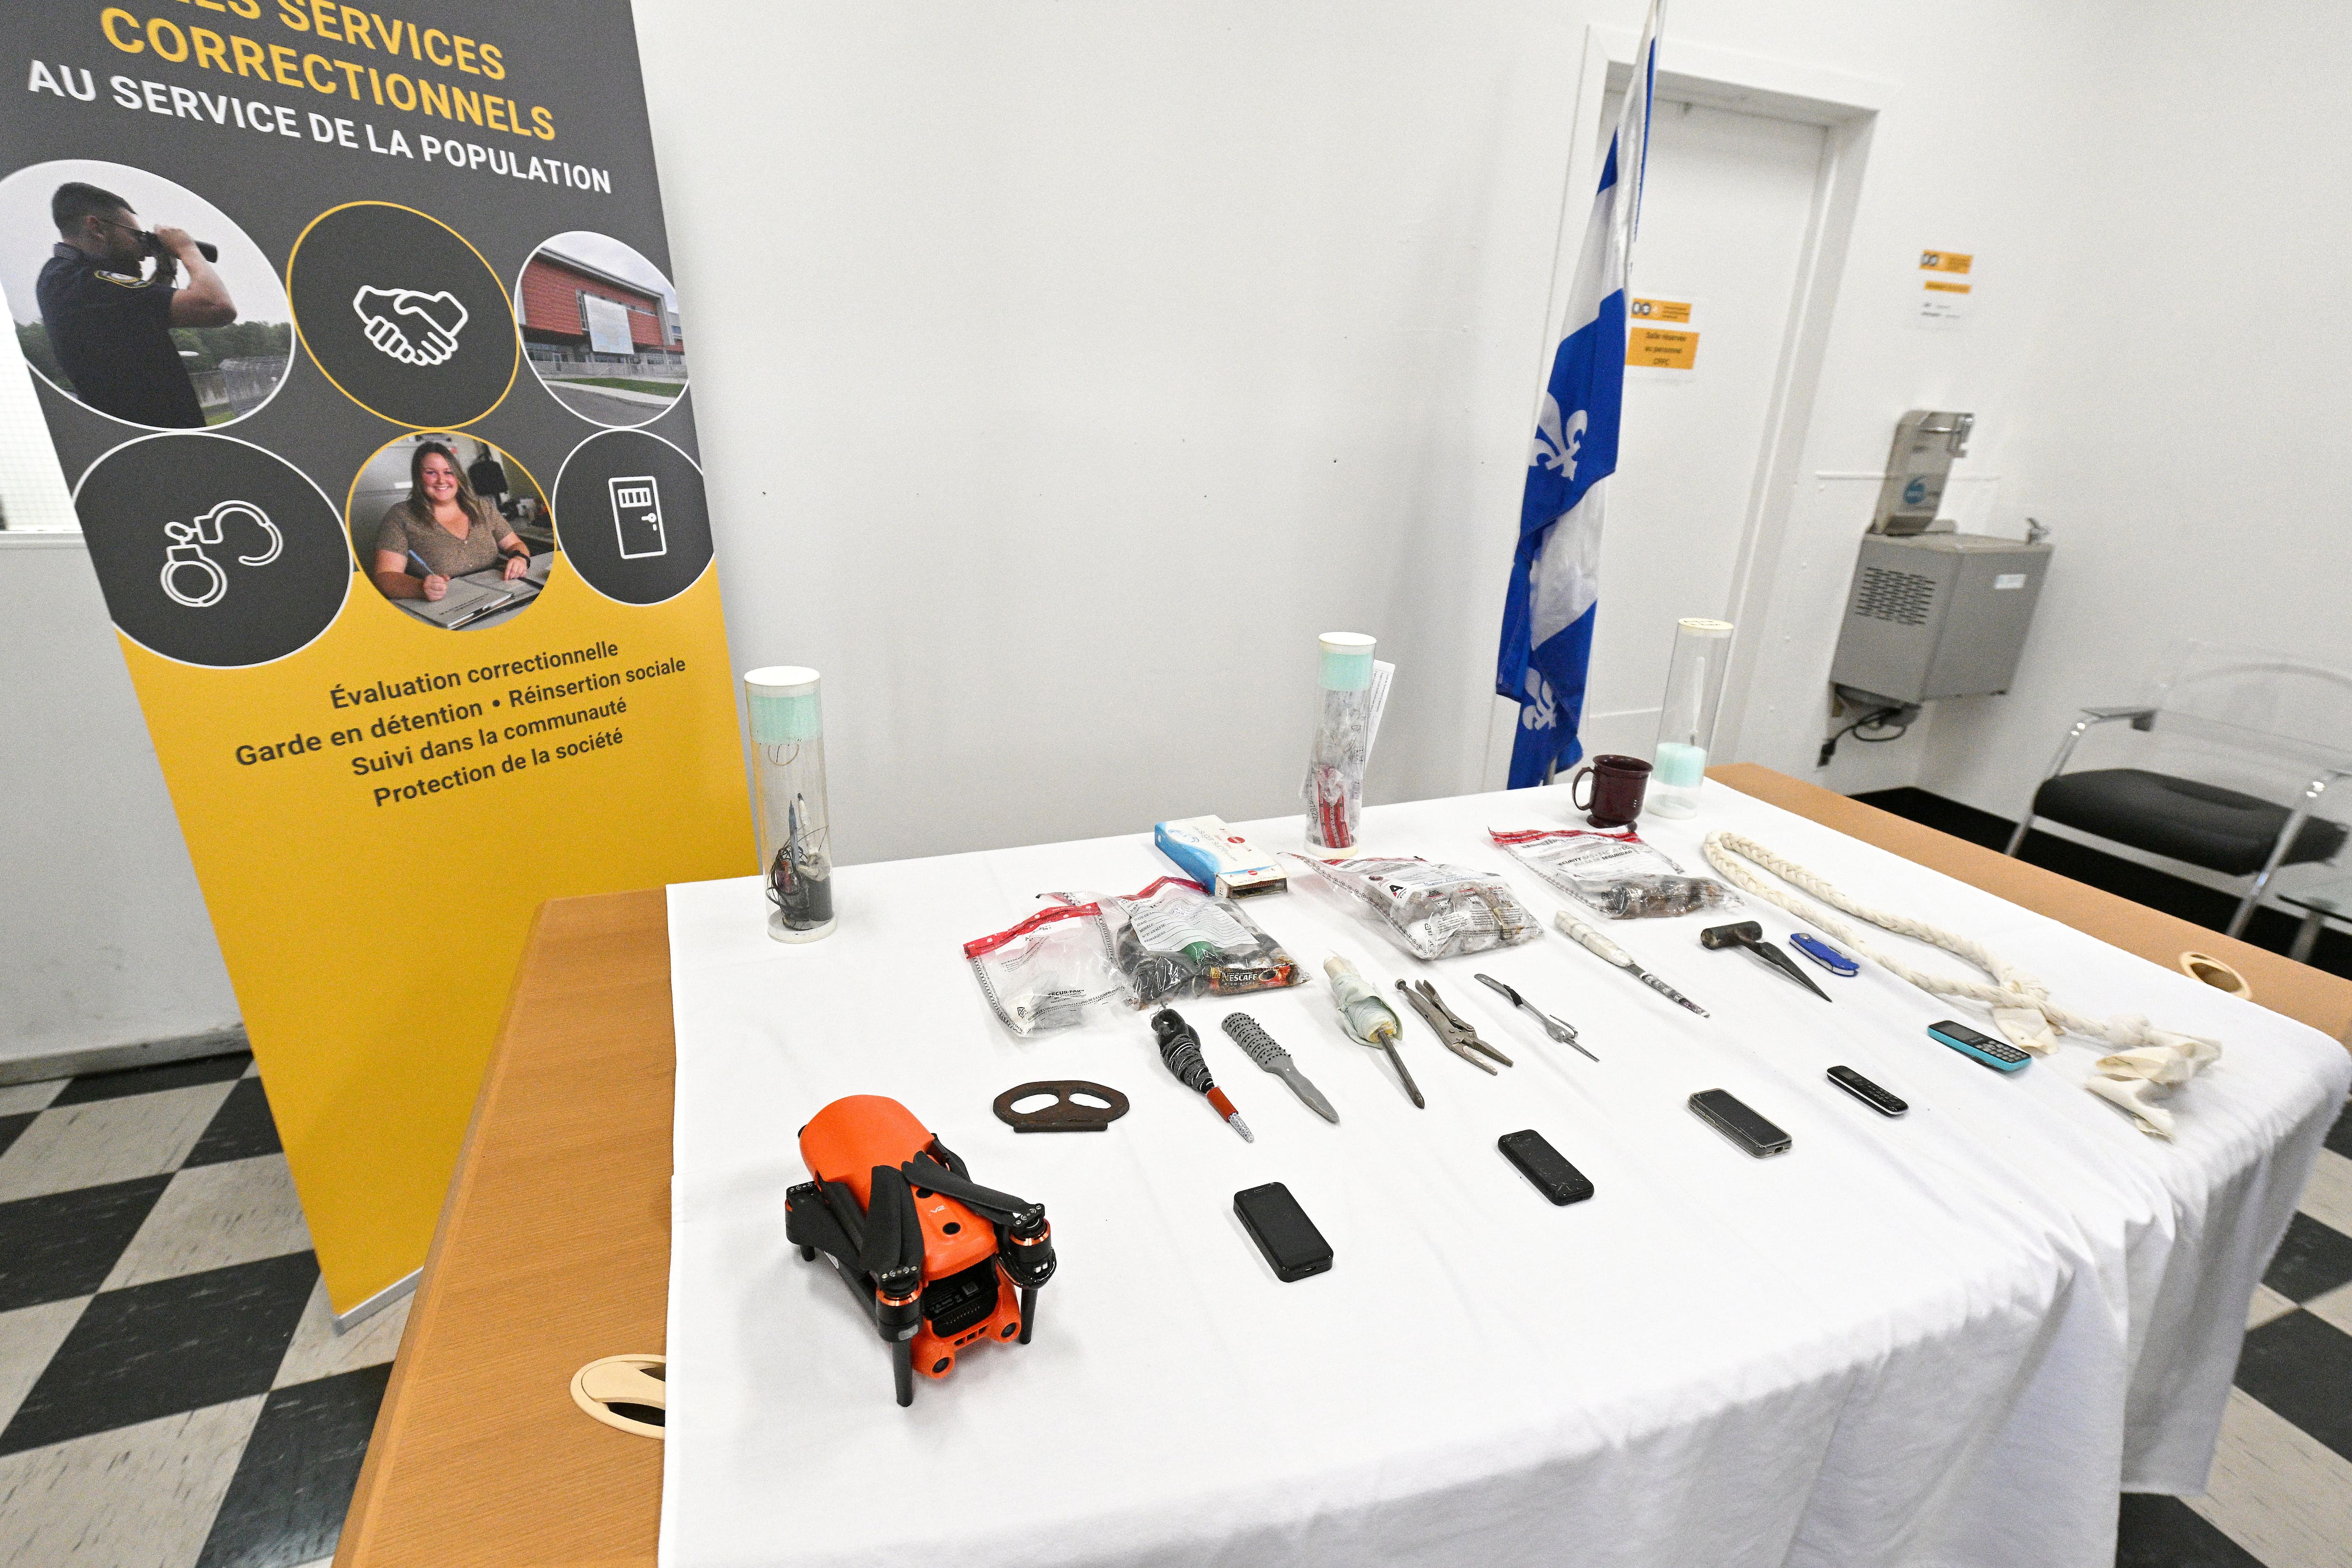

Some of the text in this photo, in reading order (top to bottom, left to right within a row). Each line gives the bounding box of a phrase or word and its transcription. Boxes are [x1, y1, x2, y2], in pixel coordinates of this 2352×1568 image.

[100, 7, 556, 141] CORRECTIONNELS
[278, 0, 506, 80] SERVICES
[27, 59, 612, 194] AU SERVICE DE LA POPULATION
[235, 657, 686, 766] Garde en détention Réinsertion sociale
[330, 641, 618, 709] Évaluation correctionnelle
[351, 696, 627, 776] Suivi dans la communauté
[373, 726, 623, 807] Protection de la société
[1557, 857, 1581, 866] ECURITY
[1601, 850, 1632, 860] SEGURIDAD
